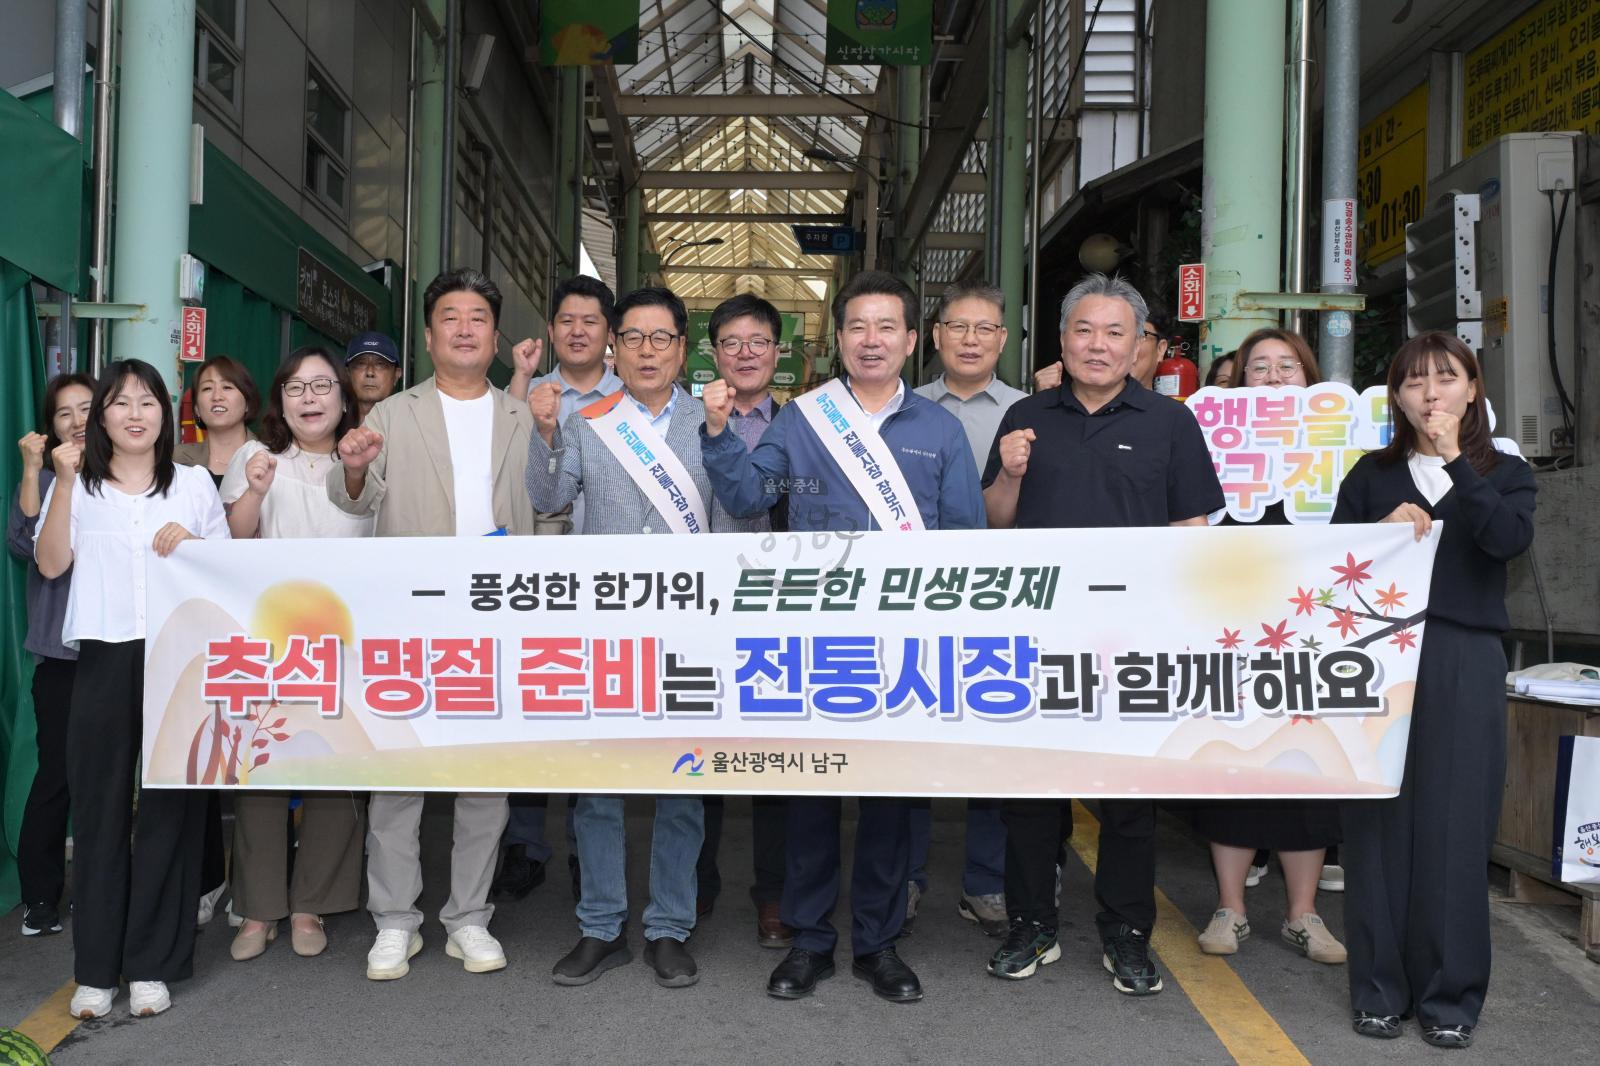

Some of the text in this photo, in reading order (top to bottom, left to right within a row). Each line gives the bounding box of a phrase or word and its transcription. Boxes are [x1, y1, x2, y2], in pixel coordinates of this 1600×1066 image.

[836, 44, 920, 60] 신정상가시장
[1358, 116, 1395, 160] 업시간
[806, 233, 828, 242] 주차장
[1381, 184, 1421, 242] 01:30
[1333, 218, 1341, 263] 울산남부소방서
[1344, 201, 1353, 282] 연결송수관설비 송수구
[1184, 268, 1200, 305] 소화기
[186, 311, 201, 347] 소화기
[1194, 392, 1351, 449] 행복을
[616, 421, 656, 466] 우리동네
[649, 463, 688, 512] 전통시장
[815, 392, 906, 521] 우리동네 전통시장 장보기
[1209, 450, 1365, 513] 구 전
[469, 573, 580, 612] 풍성한
[593, 572, 719, 616] 한가위,
[732, 568, 866, 612] 든든한
[879, 566, 1061, 611] 민생경제
[203, 635, 1380, 717] 추석 명절 준비는 전통시장과 함께 해요
[711, 751, 848, 775] 울산광역시 남구
